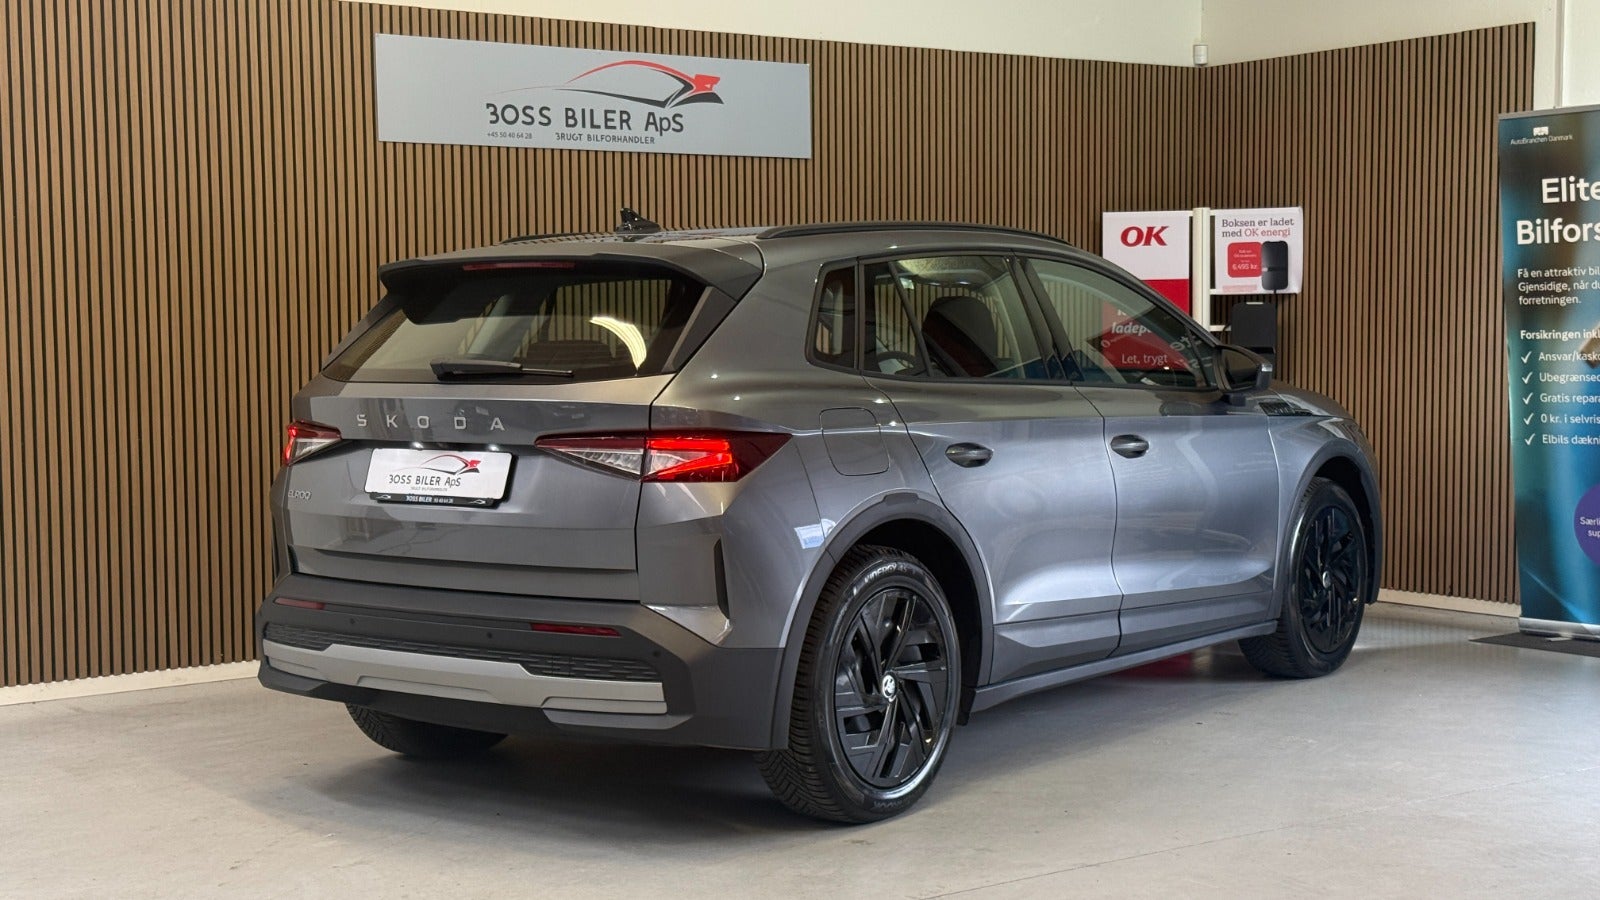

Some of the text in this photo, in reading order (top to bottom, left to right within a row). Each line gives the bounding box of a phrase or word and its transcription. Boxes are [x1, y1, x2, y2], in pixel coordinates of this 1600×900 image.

[564, 107, 632, 131] BILER
[644, 111, 684, 137] ApS
[587, 133, 656, 145] BILFORHANDLER
[1541, 175, 1600, 204] Elite
[1221, 217, 1295, 228] Boksen er ladet
[1120, 226, 1169, 247] OK
[1222, 227, 1291, 238] med OK energi
[1517, 268, 1529, 278] Få
[1544, 267, 1586, 277] attraktiv
[1518, 281, 1571, 294] Gjensidige,
[1573, 280, 1589, 290] når
[1518, 295, 1582, 307] forretningen.
[1111, 321, 1152, 337] ladep
[1520, 329, 1581, 342] Forsikringen
[1143, 354, 1168, 367] trygt
[1540, 393, 1570, 403] Gratis
[1540, 413, 1548, 423] 0
[1549, 414, 1562, 423] kr.
[1542, 434, 1569, 444] Elbils
[415, 475, 441, 486] BILER
[444, 476, 462, 488] ApS
